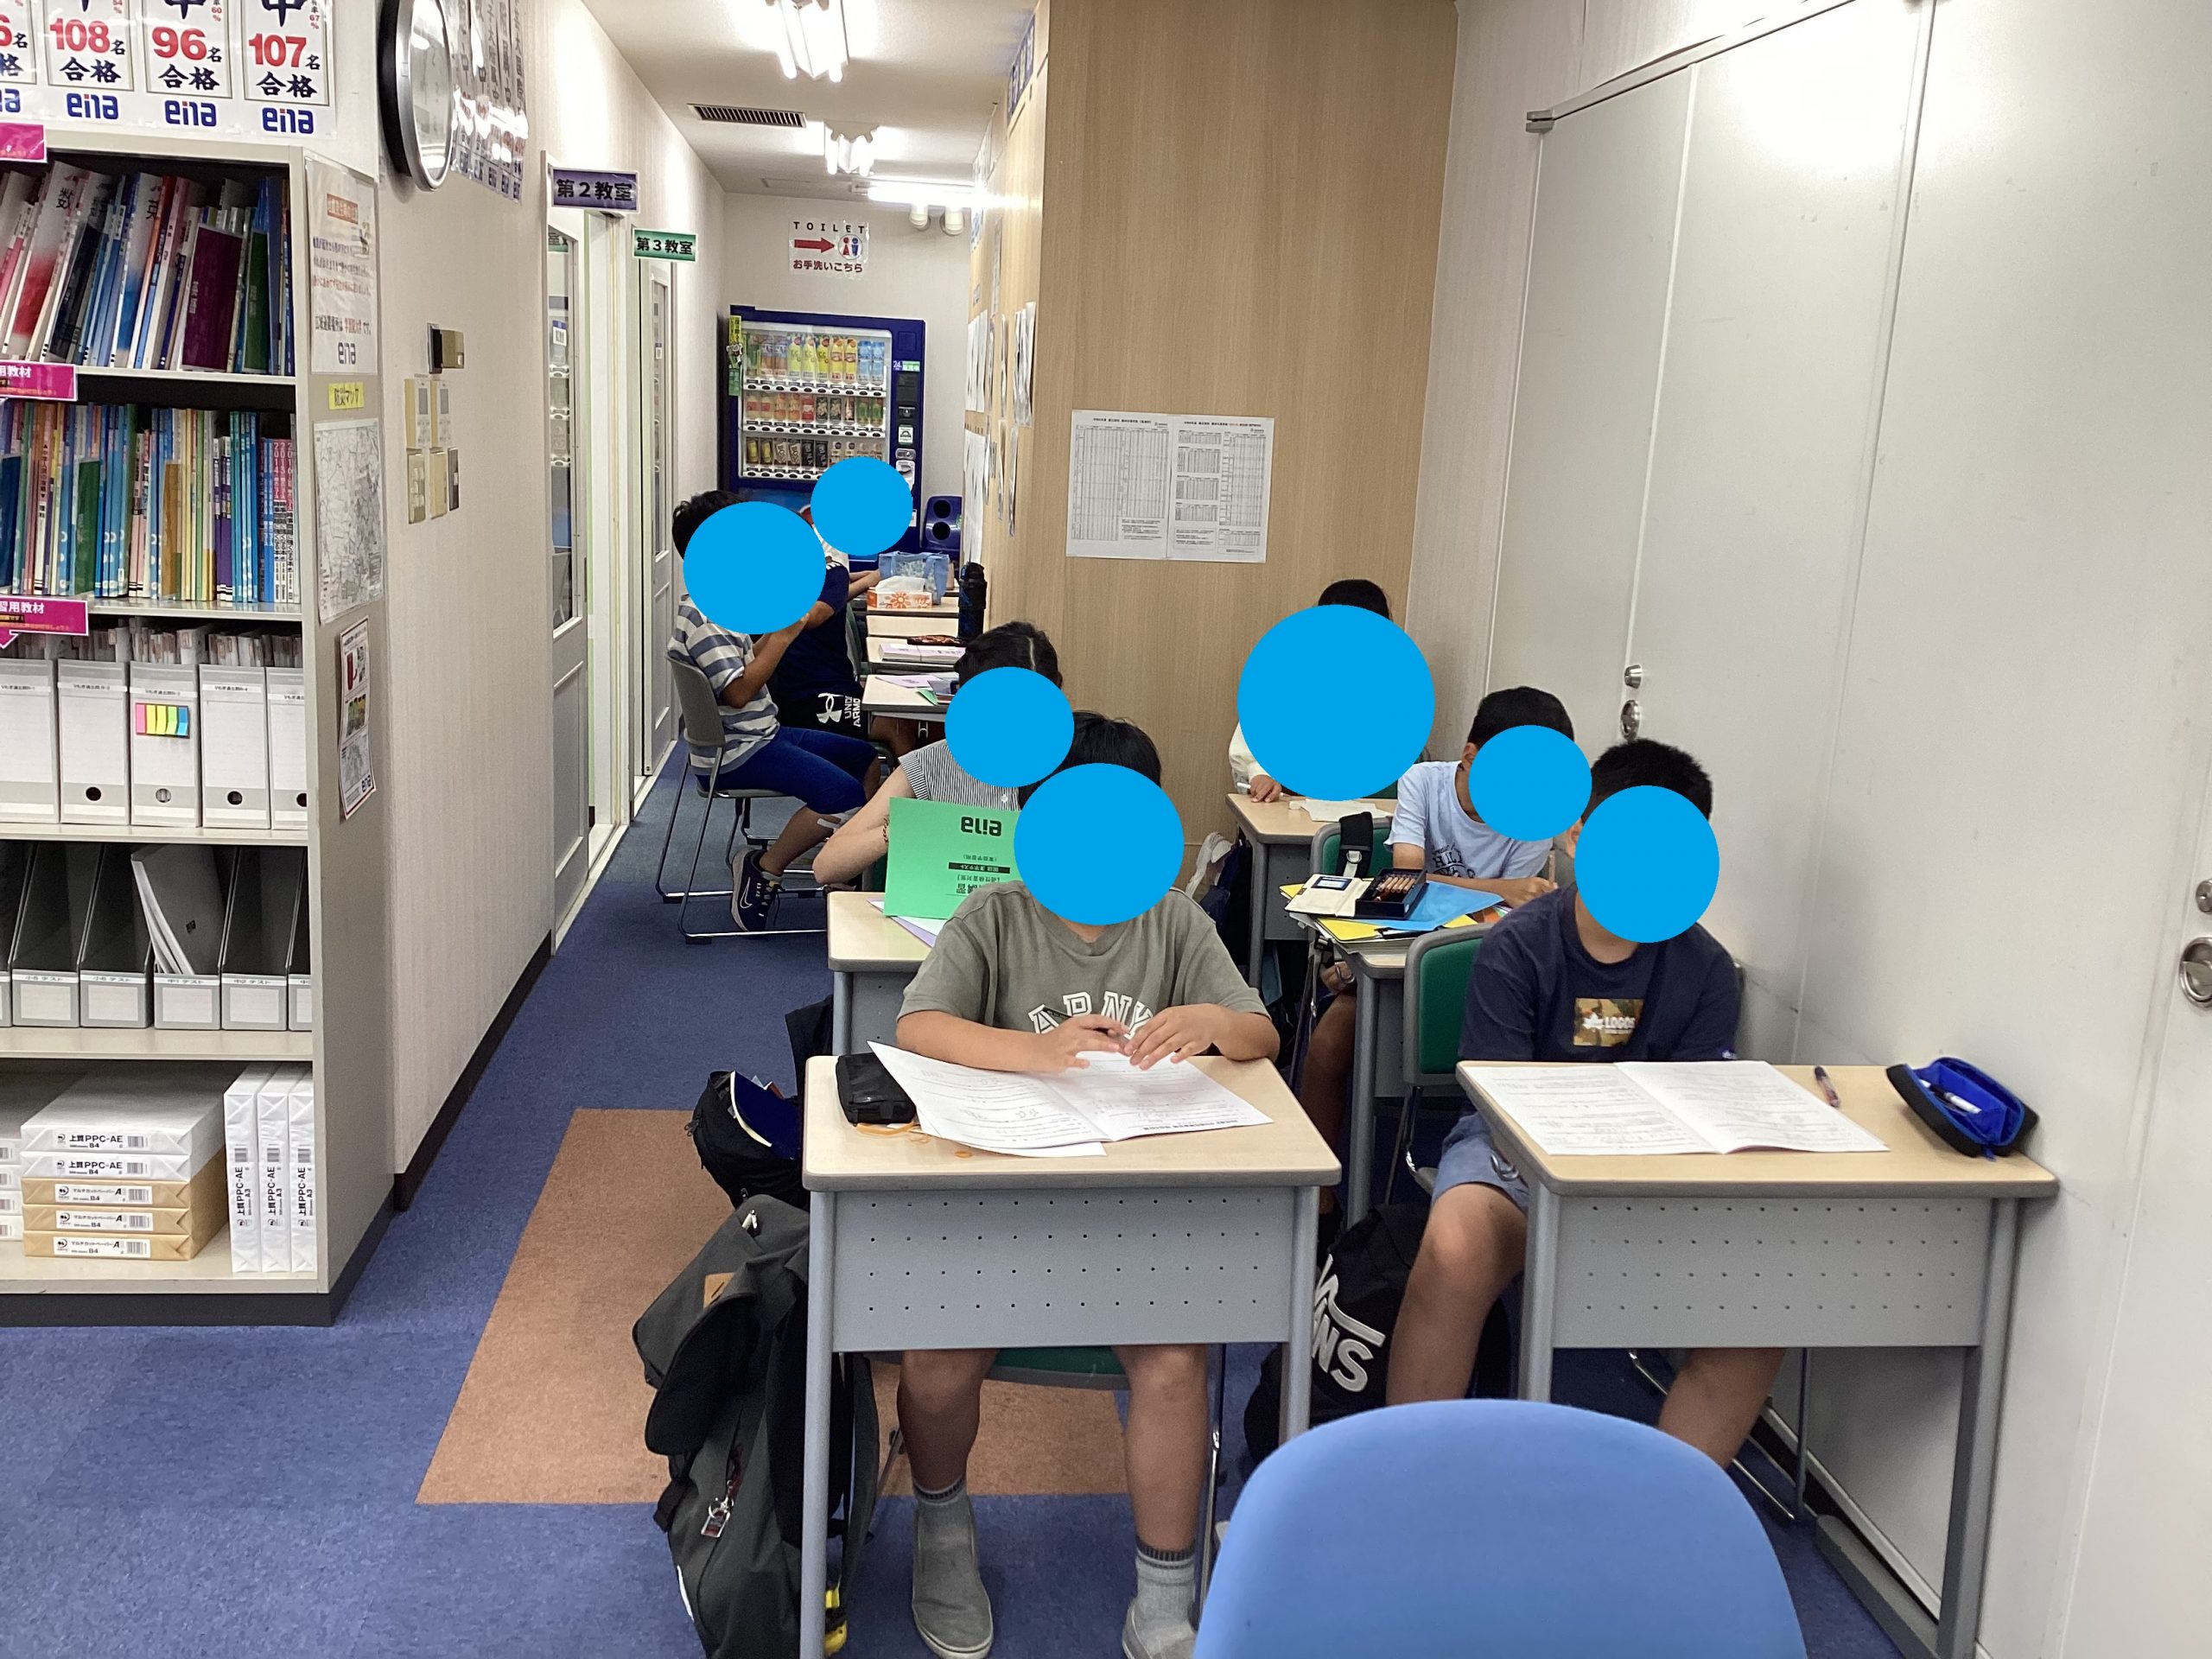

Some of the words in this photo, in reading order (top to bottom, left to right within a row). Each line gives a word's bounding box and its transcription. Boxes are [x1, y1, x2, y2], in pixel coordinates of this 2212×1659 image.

[60, 56, 122, 84] 合格
[158, 64, 220, 91] 合格
[256, 71, 317, 98] 合格
[556, 179, 632, 201] 第2教室
[793, 221, 864, 234] TOILET
[636, 237, 693, 255] 第3教室
[793, 260, 862, 272] お手洗いこちら
[853, 697, 861, 727] ARMO
